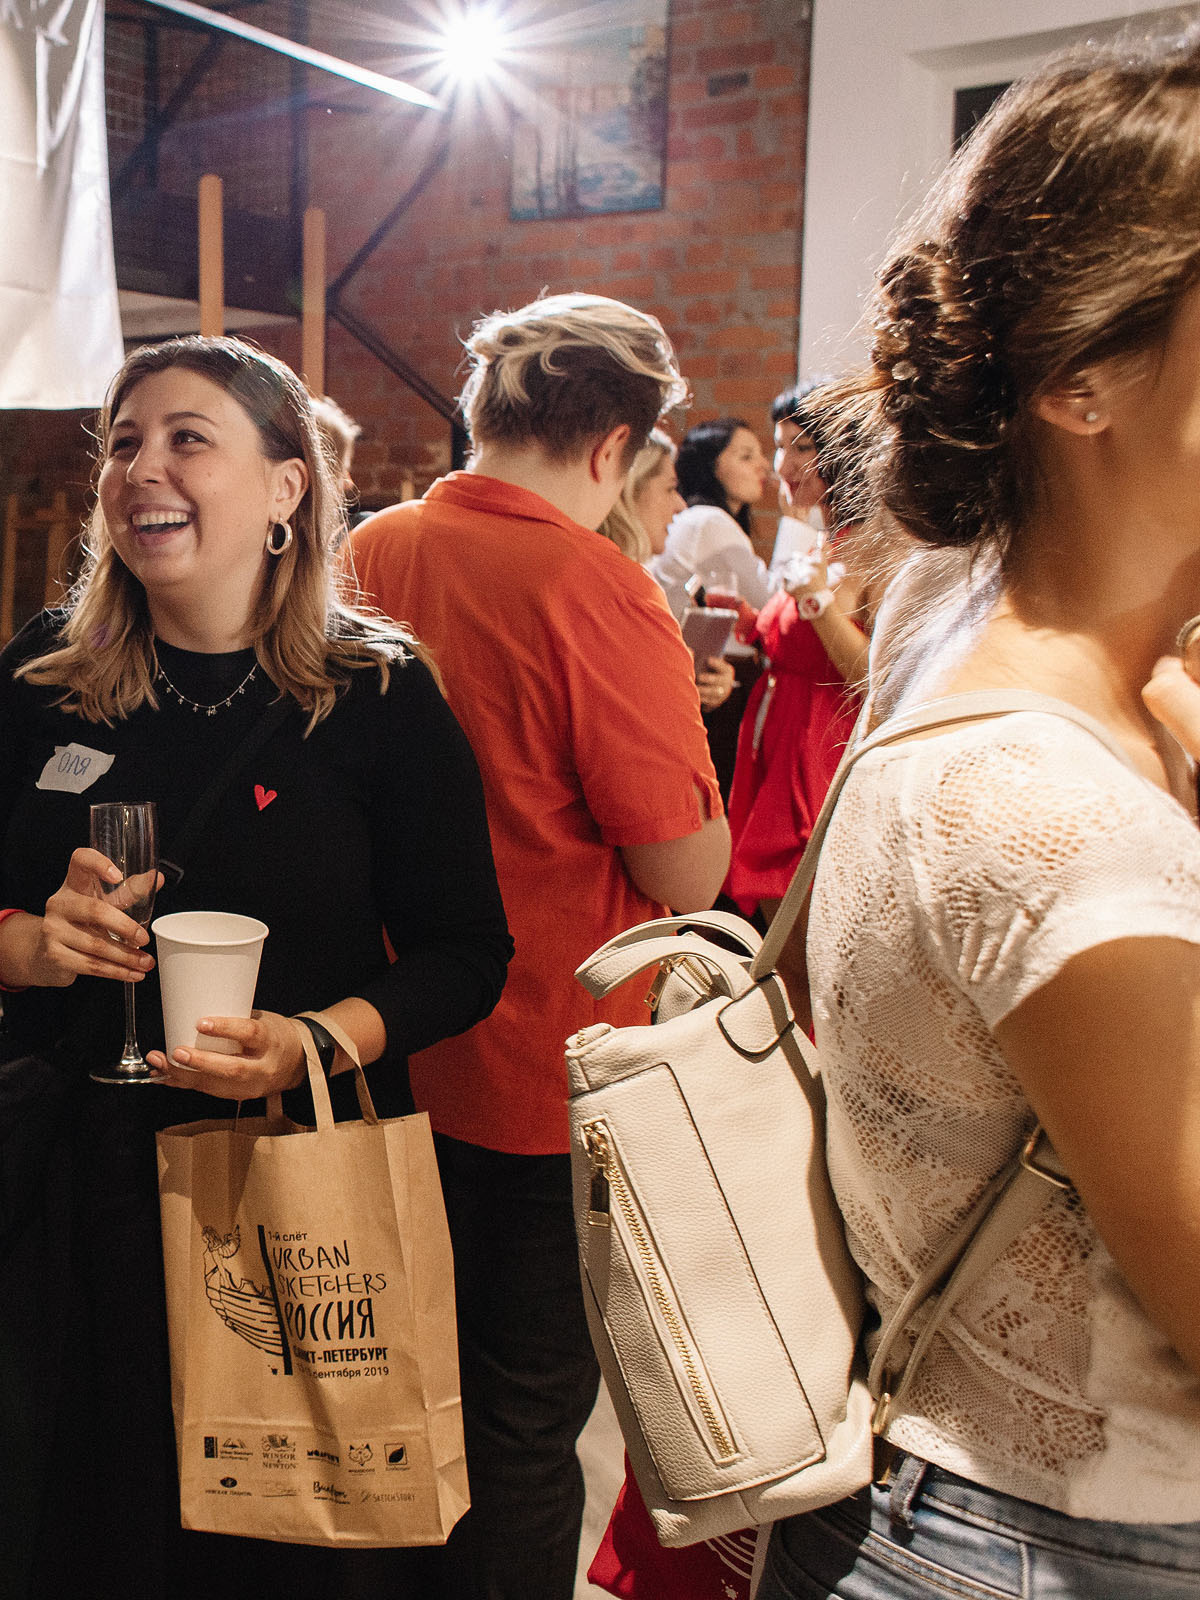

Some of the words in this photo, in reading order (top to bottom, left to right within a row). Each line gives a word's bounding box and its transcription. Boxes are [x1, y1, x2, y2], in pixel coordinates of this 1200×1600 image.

[57, 751, 92, 776] ОЛЯ
[282, 1230, 308, 1242] слёт
[272, 1239, 350, 1272] URBAN
[277, 1273, 387, 1299] SKETCHERS
[284, 1298, 375, 1341] РОССИЯ
[363, 1366, 389, 1377] 2019
[262, 1452, 296, 1460] WINSOR
[262, 1461, 297, 1470] NEWTON
